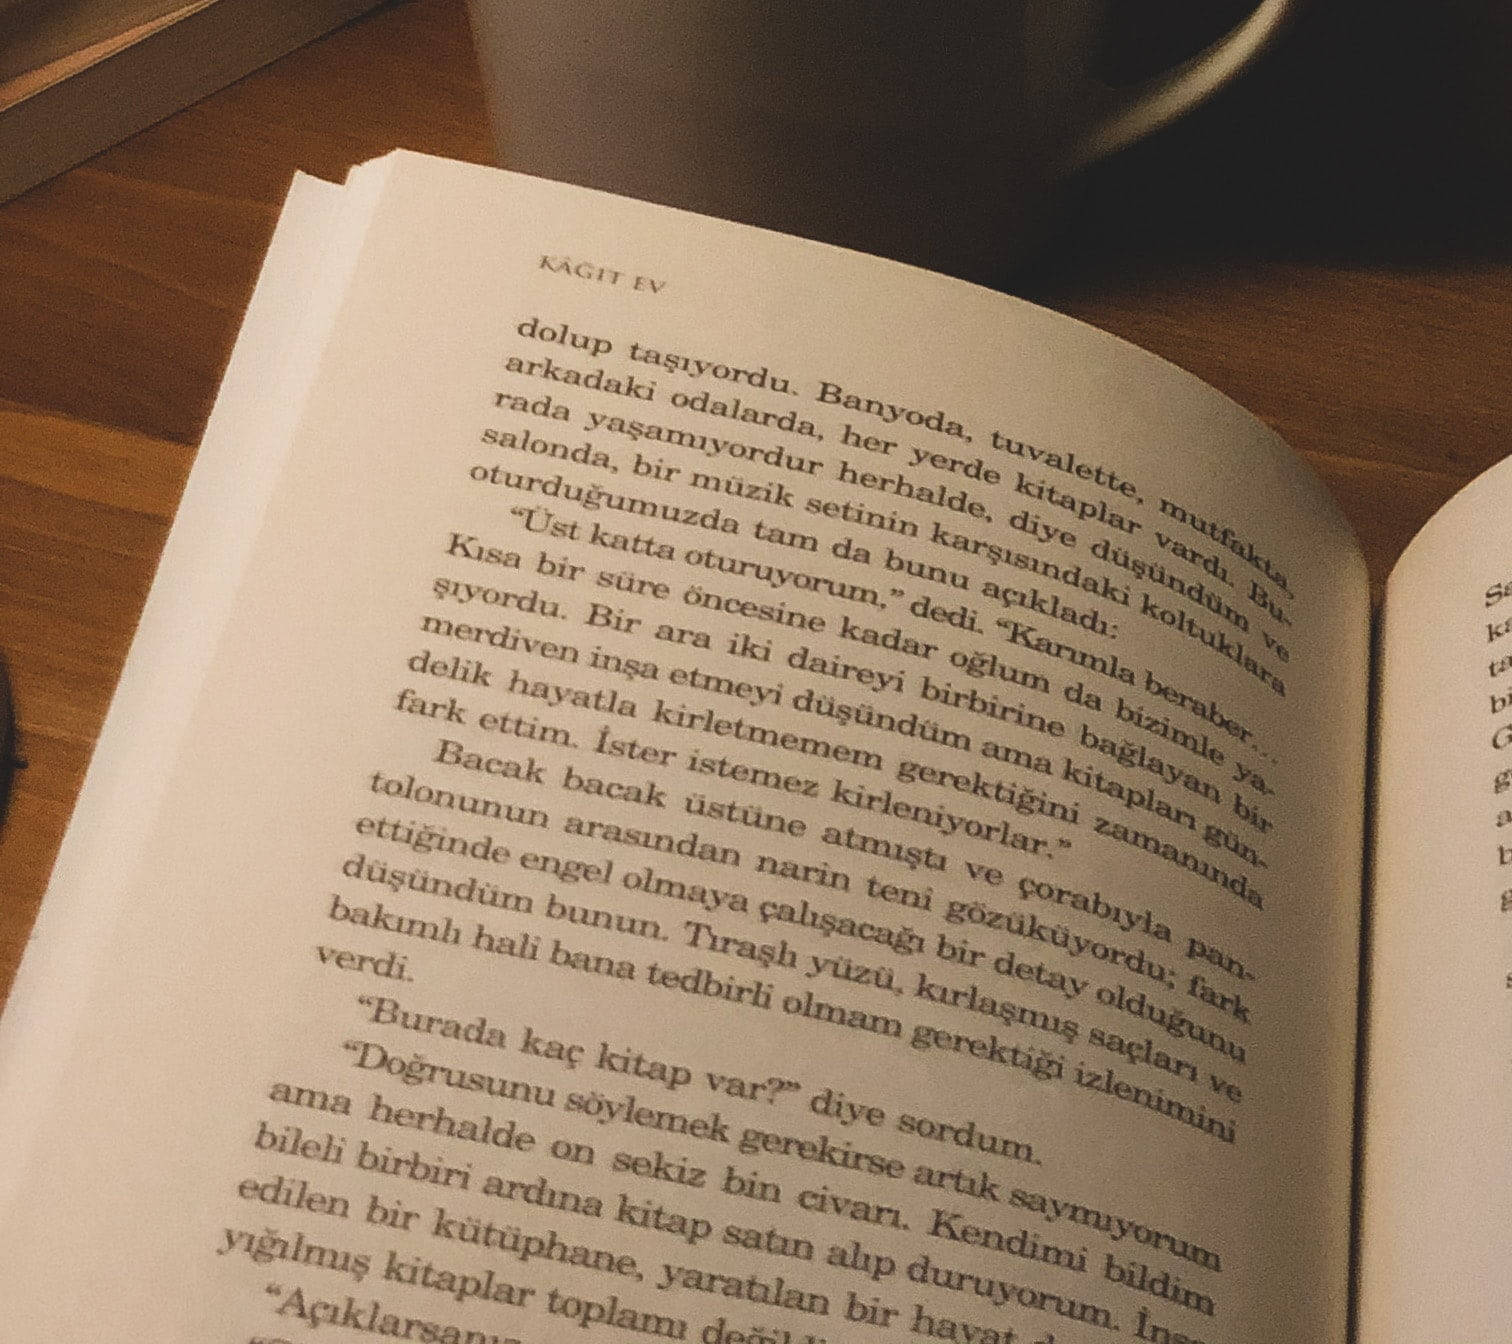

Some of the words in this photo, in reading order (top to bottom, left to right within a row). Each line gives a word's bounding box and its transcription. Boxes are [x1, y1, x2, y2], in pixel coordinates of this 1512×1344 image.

[632, 275, 668, 295] EV
[516, 316, 613, 359] dolup
[504, 356, 657, 403] arkadaki
[840, 422, 899, 456] her
[907, 447, 1001, 486] yerde
[1014, 470, 1143, 536] kitaplar
[632, 452, 682, 483] bir
[689, 471, 794, 509] müzik
[804, 497, 919, 539] setinin
[753, 520, 819, 554] tam
[831, 536, 871, 566] da
[884, 546, 970, 592] bunu
[407, 649, 492, 688] delik
[507, 668, 637, 719] hayatla
[395, 687, 466, 726] fark
[687, 755, 819, 799] istemez
[433, 738, 544, 786] Bacak
[562, 765, 666, 810] bacak
[684, 796, 807, 838] üstüne
[965, 860, 1004, 888] ve
[355, 817, 511, 865] ettiğinde
[519, 852, 614, 886] engel
[622, 866, 749, 915] olmaya
[935, 932, 987, 969] bir
[993, 950, 1089, 1001] detay
[1095, 984, 1247, 1066] olduğunu
[519, 1026, 585, 1071] kaç
[595, 1041, 692, 1092] kitap
[809, 1087, 886, 1128] diye
[268, 1082, 352, 1117] ama
[368, 1093, 536, 1153] herhalde
[550, 1139, 595, 1167] on
[611, 1149, 707, 1189] sekiz
[721, 1164, 781, 1205] bin
[926, 1207, 1088, 1274] Kendimi
[1103, 1252, 1216, 1319] bildim
